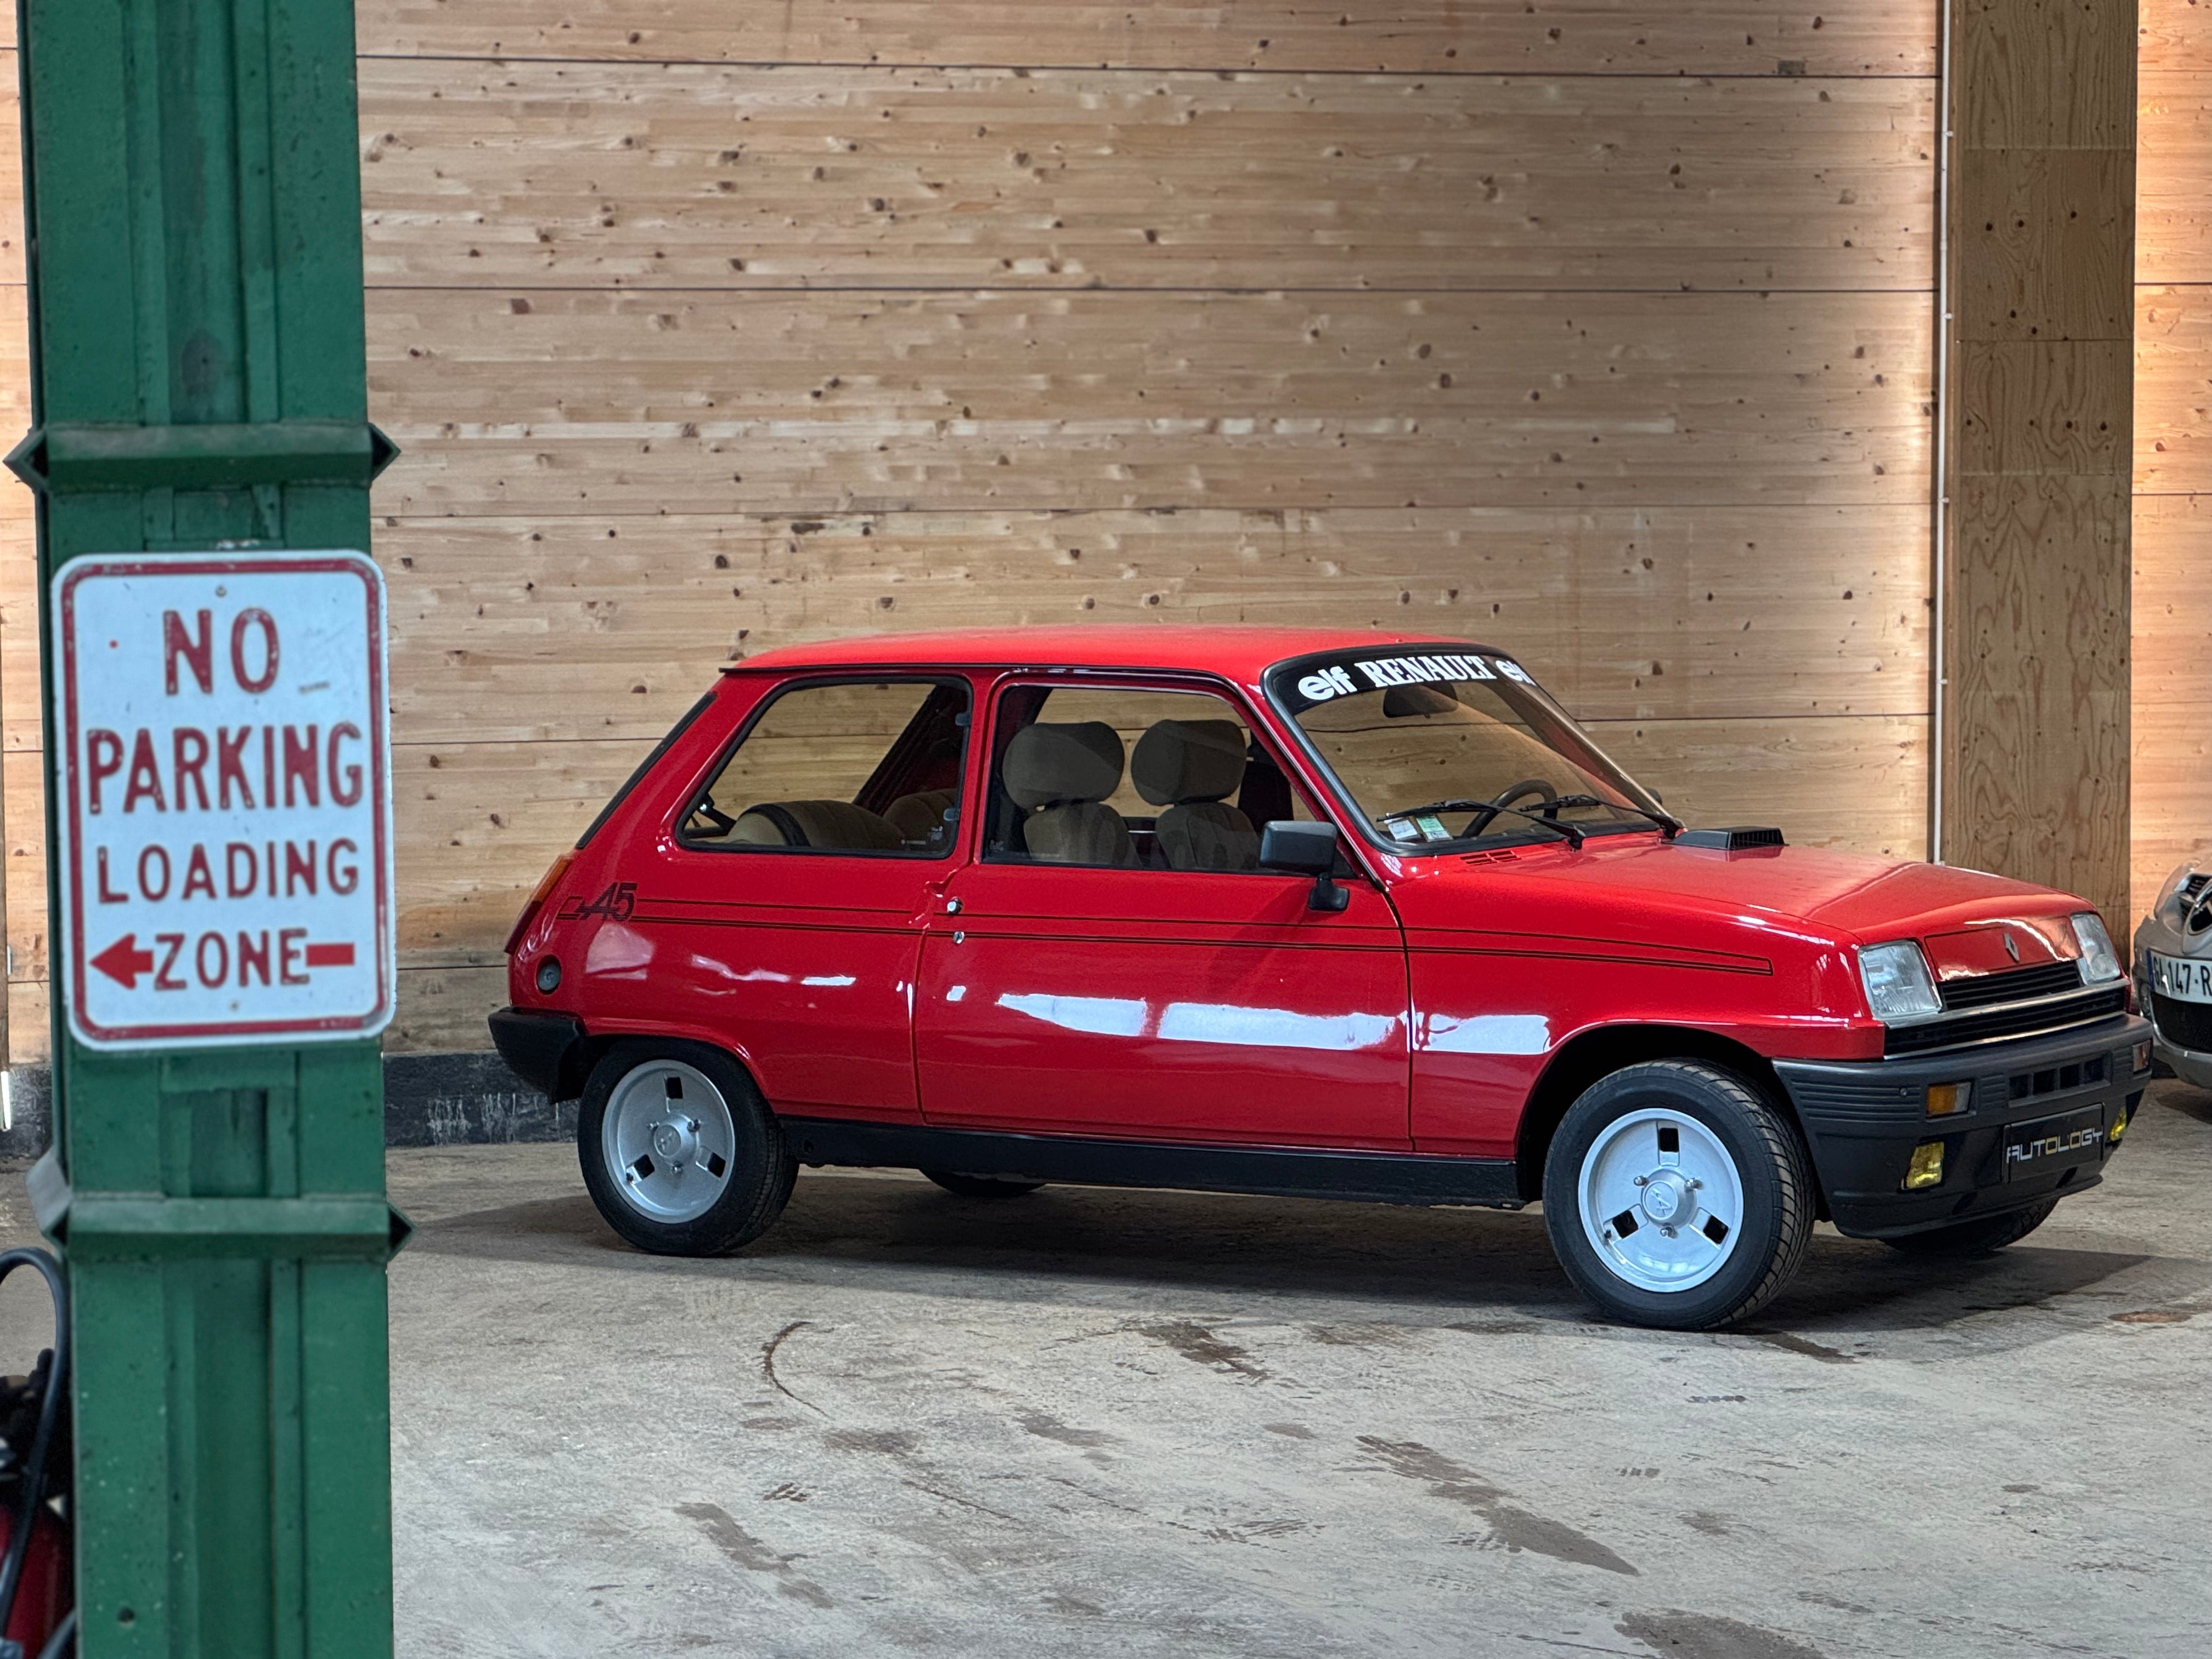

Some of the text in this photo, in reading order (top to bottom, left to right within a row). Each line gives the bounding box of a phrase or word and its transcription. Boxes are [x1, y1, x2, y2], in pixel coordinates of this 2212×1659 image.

[163, 607, 280, 696] NO
[1298, 665, 1358, 701] elf
[1355, 655, 1497, 687] RENAULT
[87, 721, 363, 814] PARKING
[97, 838, 359, 904] LOADING
[153, 928, 309, 991] ZONE
[2006, 1126, 2103, 1164] AUTOLOGY
